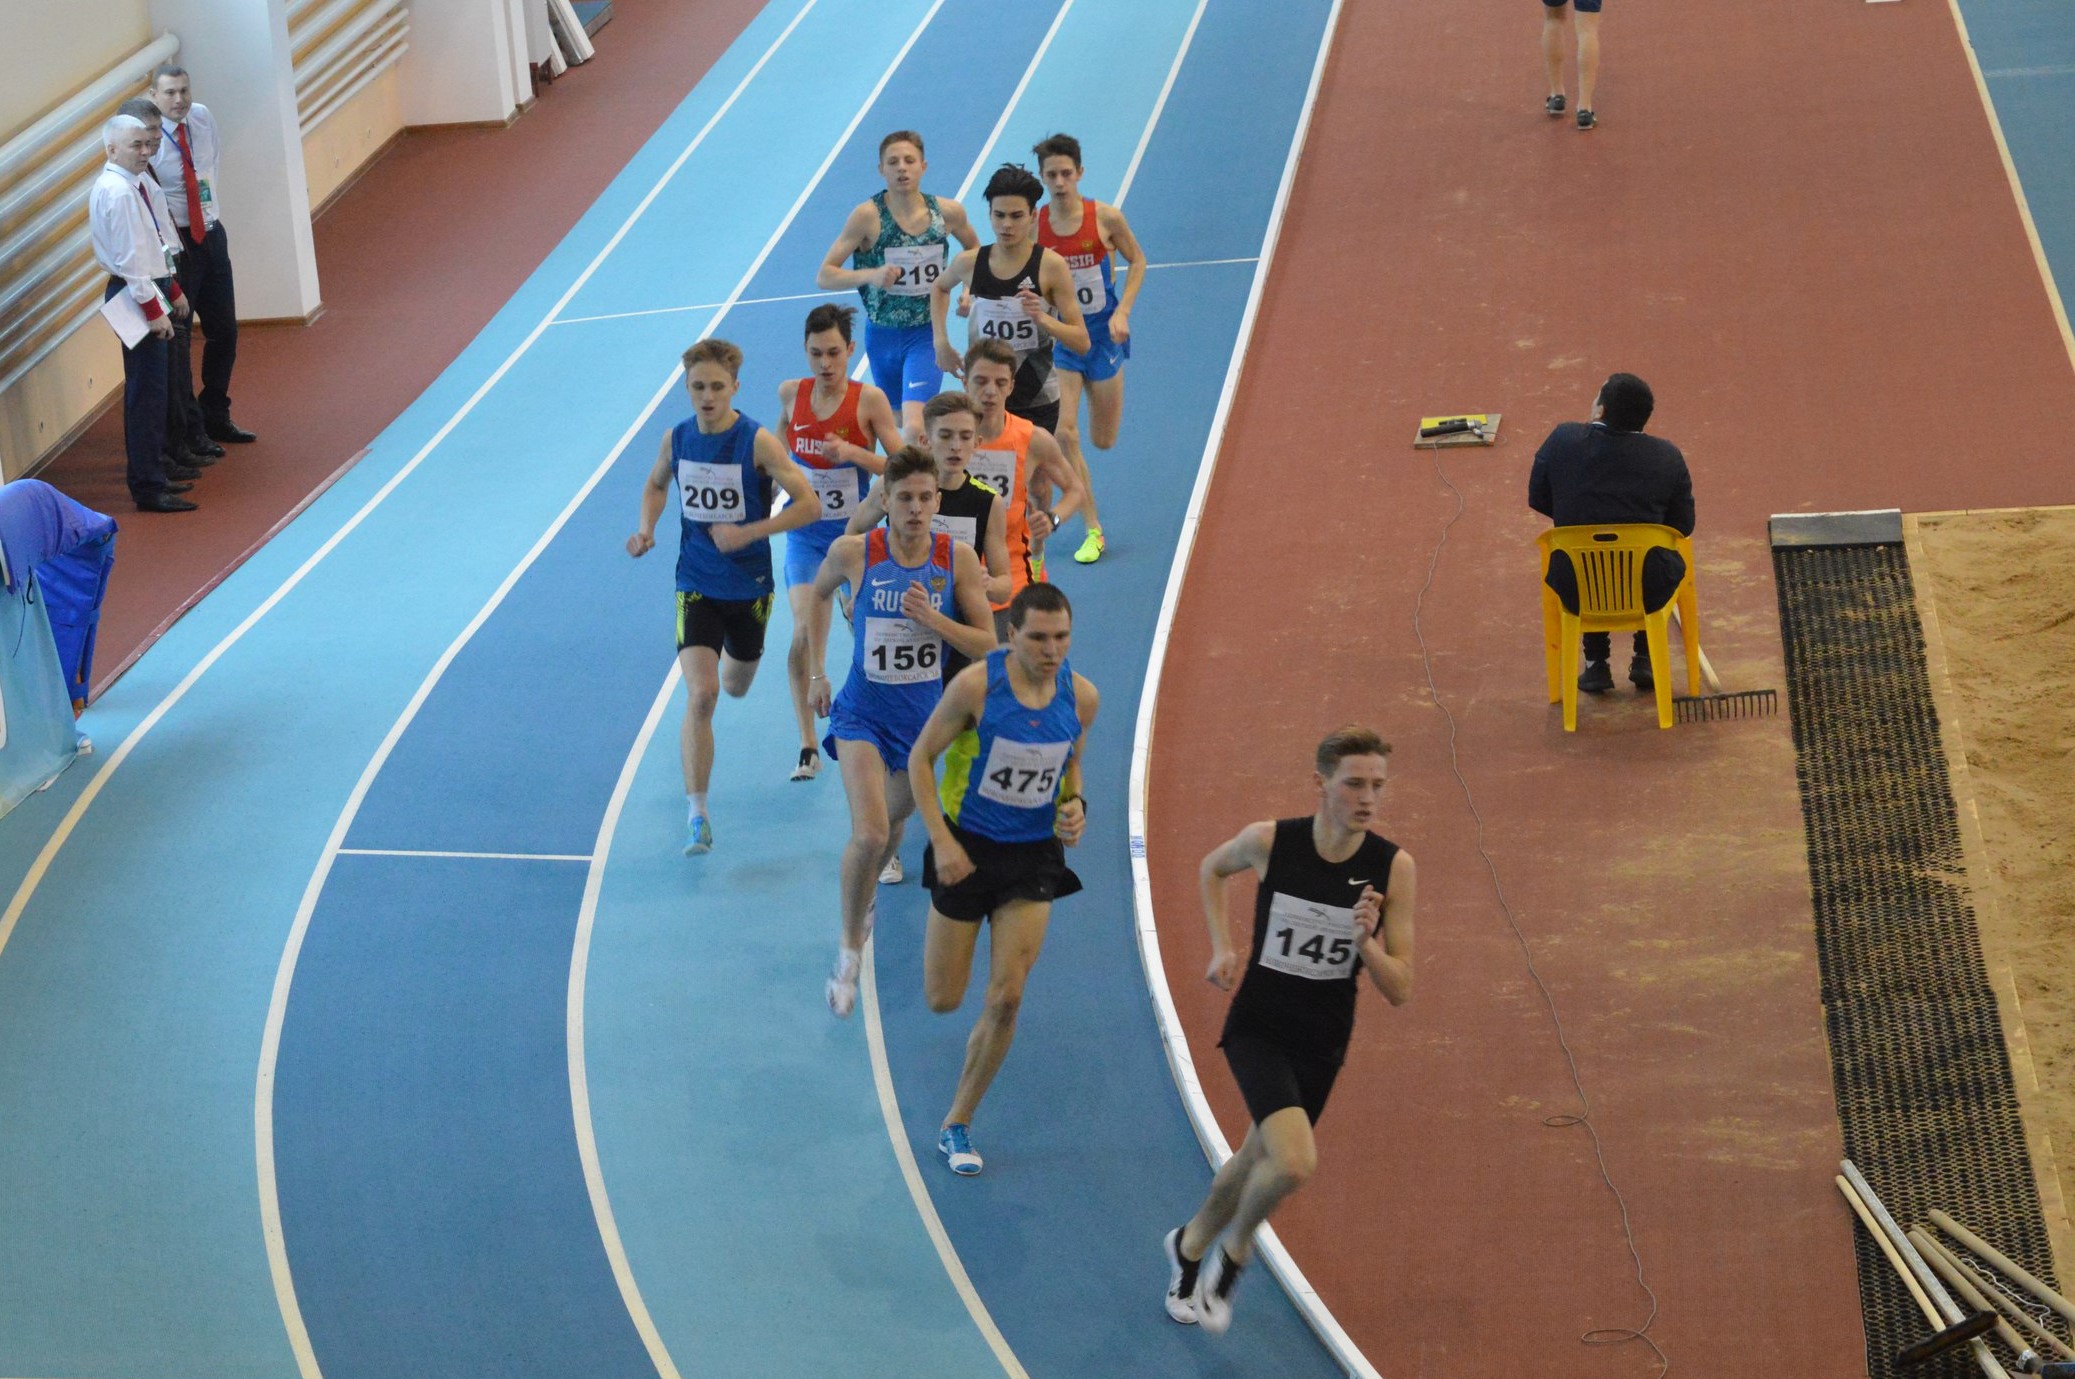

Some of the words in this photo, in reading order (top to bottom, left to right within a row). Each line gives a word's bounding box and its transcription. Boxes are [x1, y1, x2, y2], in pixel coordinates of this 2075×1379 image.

[1064, 253, 1095, 268] SIA
[893, 263, 940, 286] 219
[982, 319, 1034, 340] 405
[796, 437, 824, 455] RUS
[684, 484, 740, 510] 209
[871, 643, 937, 671] 156
[990, 765, 1055, 793] 475
[1276, 927, 1353, 965] 145
